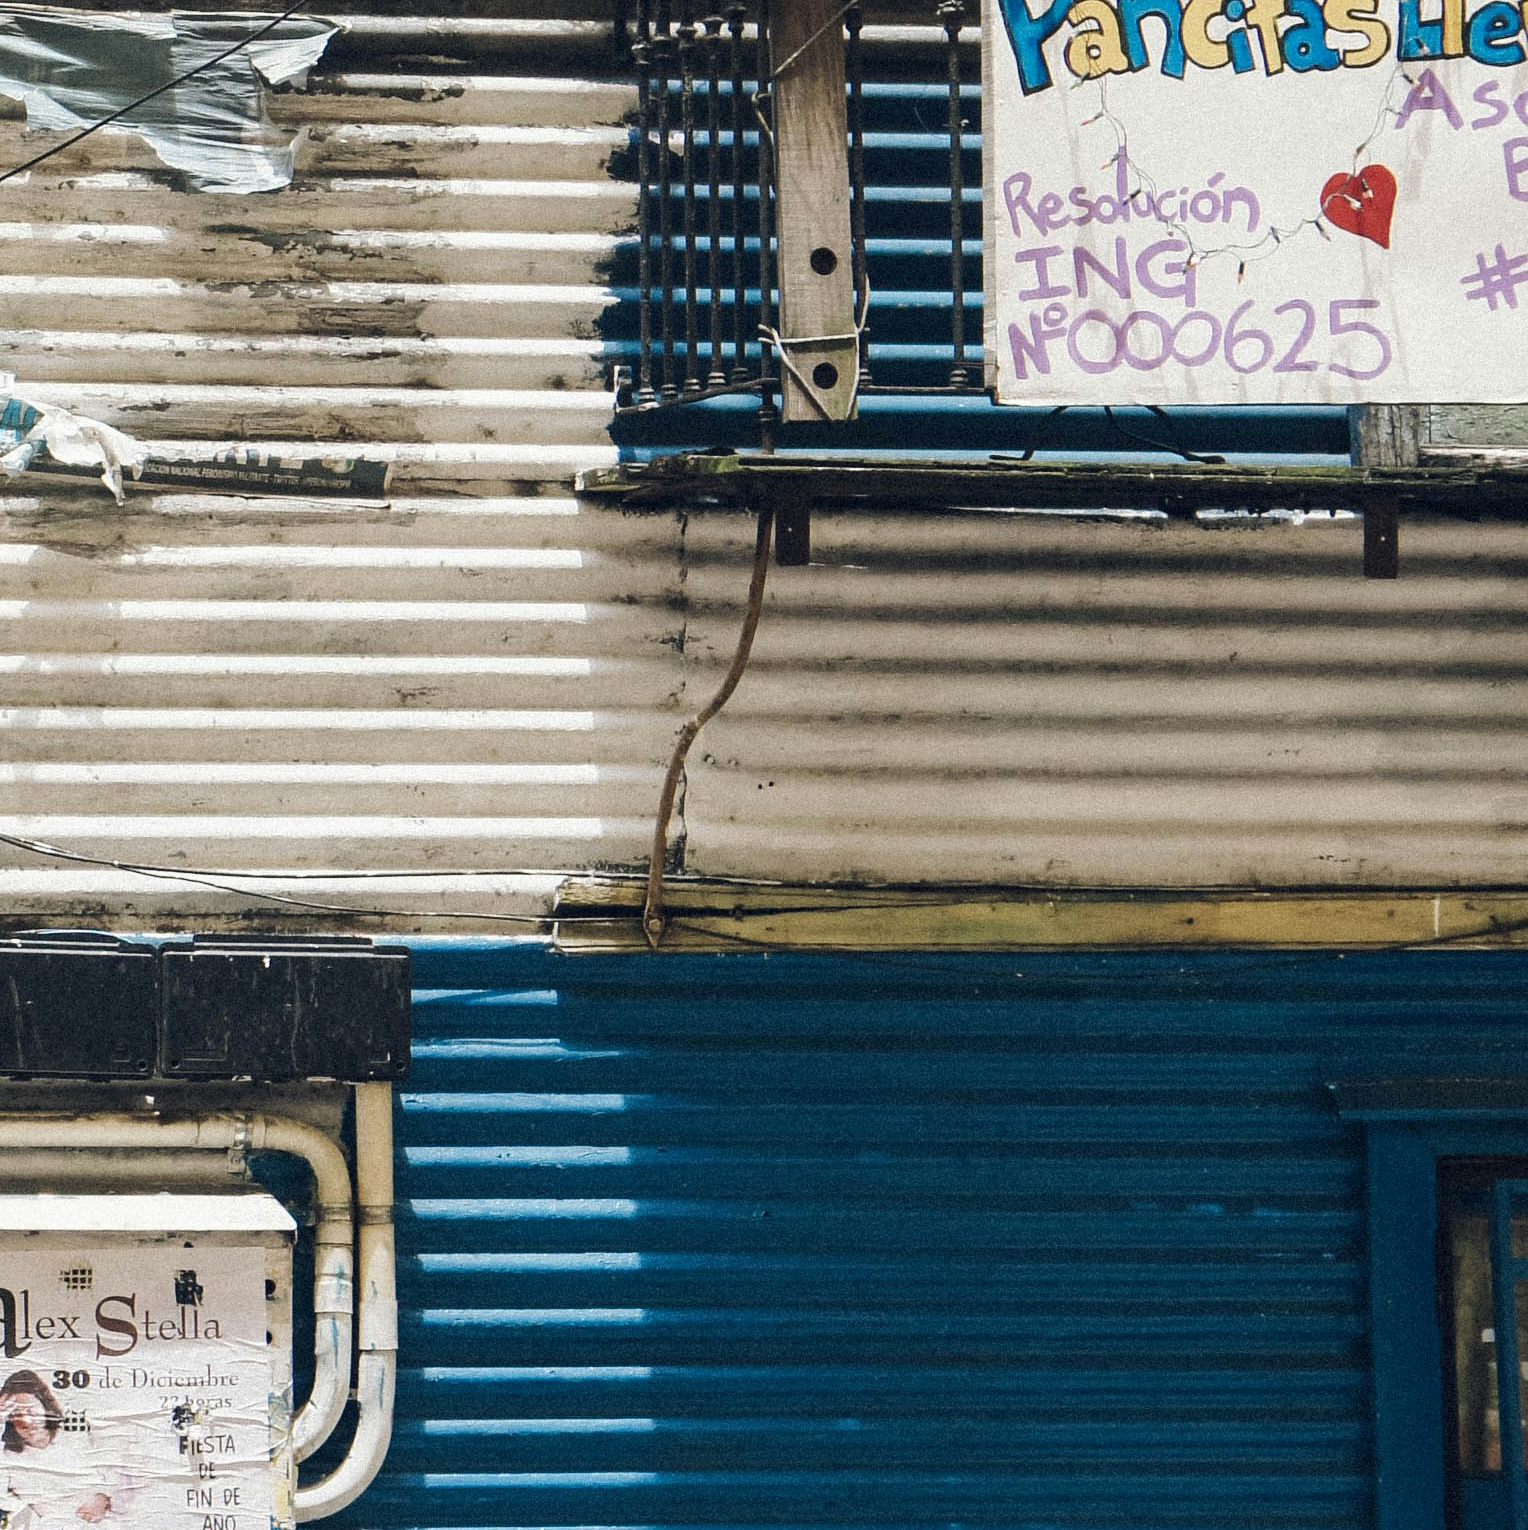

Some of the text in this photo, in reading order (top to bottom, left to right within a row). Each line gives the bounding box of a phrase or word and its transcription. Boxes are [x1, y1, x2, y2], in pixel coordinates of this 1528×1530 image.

[1003, 146, 1261, 237] Resolución
[1014, 236, 1197, 308] ING
[95, 1293, 223, 1360] Stella
[52, 1364, 241, 1389] 30 de Diciembre
[179, 1435, 236, 1456] FIESTA
[198, 1462, 217, 1480] DE
[186, 1487, 241, 1509] FIN DE
